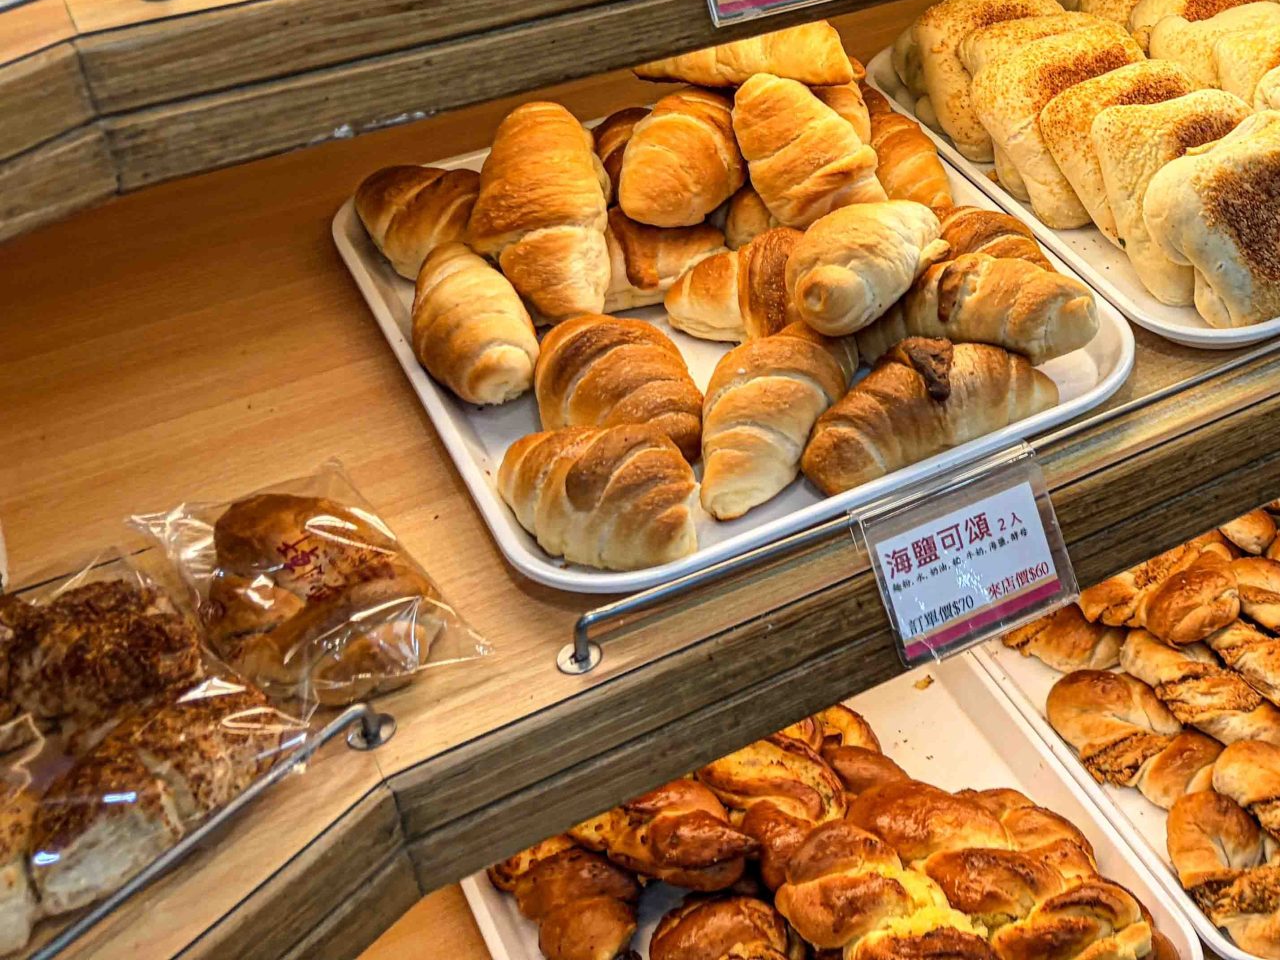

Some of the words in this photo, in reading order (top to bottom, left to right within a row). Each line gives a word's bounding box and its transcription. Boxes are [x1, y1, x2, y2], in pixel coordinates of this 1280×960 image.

[884, 512, 992, 580] 海鹽可頌
[908, 595, 974, 636] 訂單價$70
[987, 561, 1050, 600] 來店價$60
